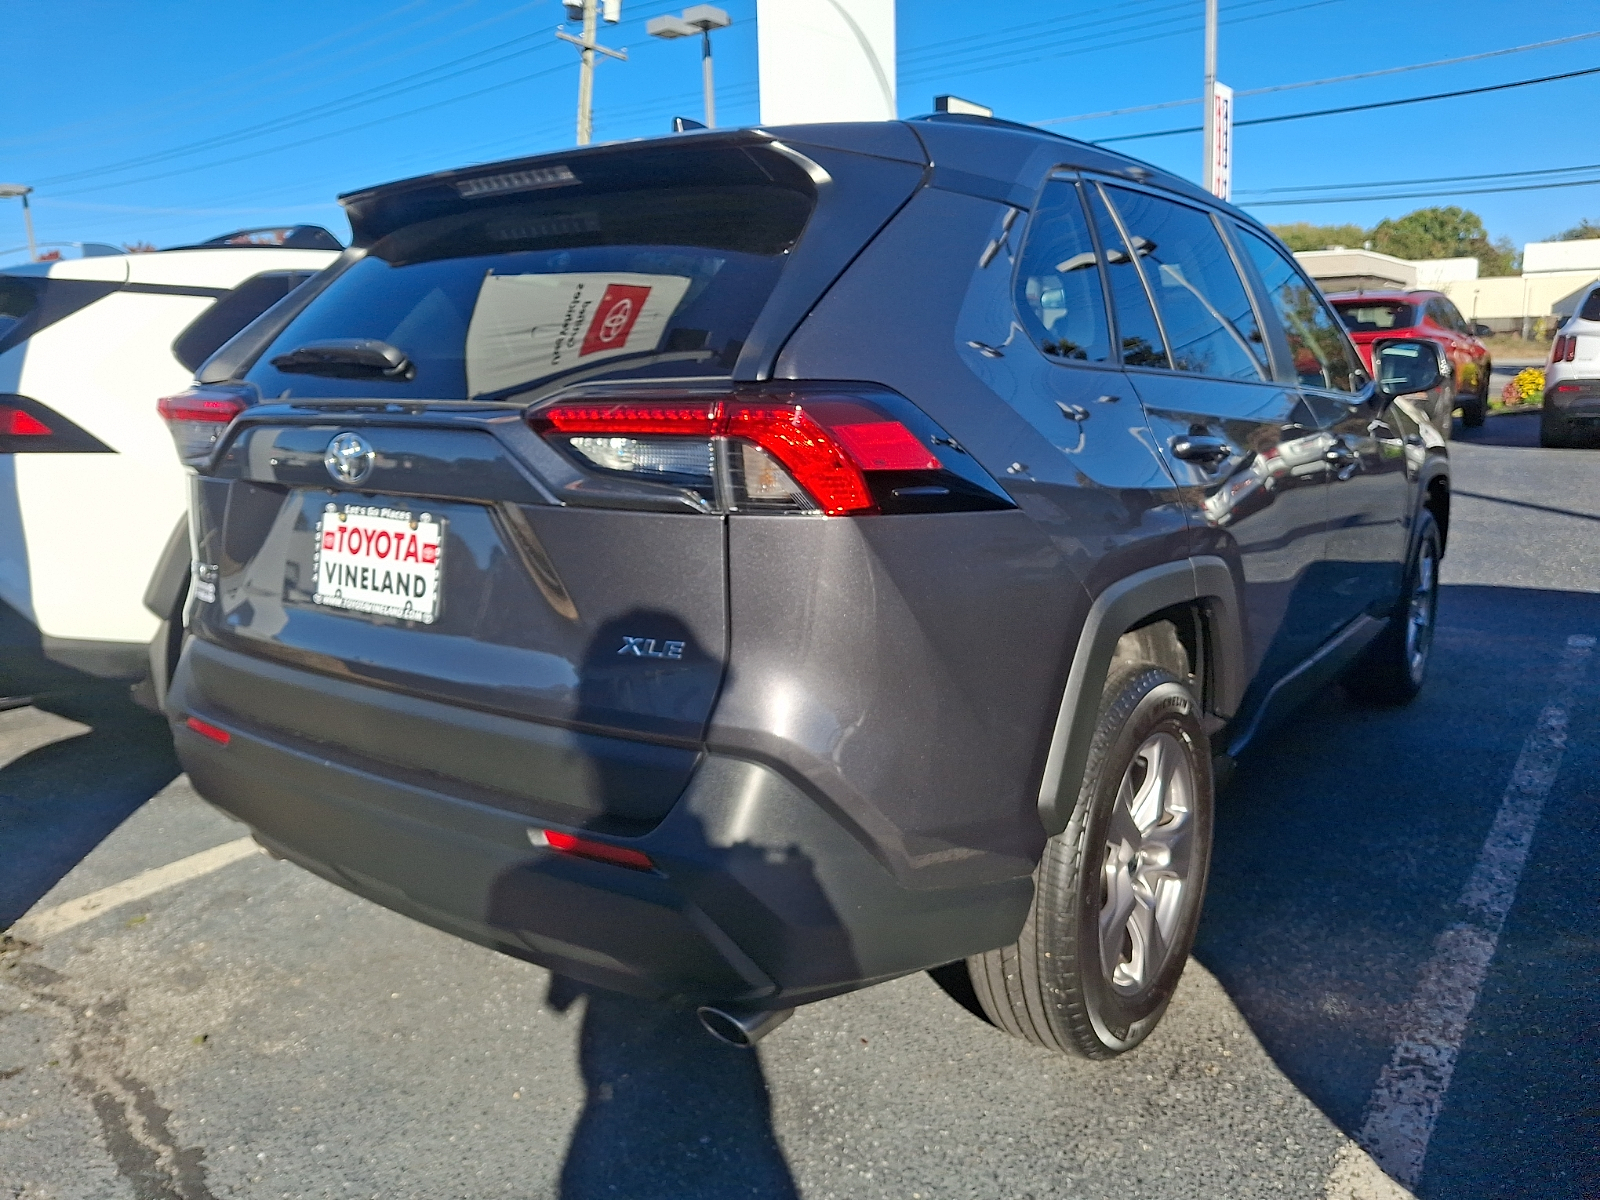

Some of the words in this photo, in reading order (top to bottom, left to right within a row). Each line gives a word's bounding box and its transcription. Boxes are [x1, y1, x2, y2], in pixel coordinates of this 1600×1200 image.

[367, 506, 380, 516] Go
[338, 526, 419, 563] TOYOTA
[325, 561, 426, 598] VINELAND
[617, 635, 686, 659] XLE
